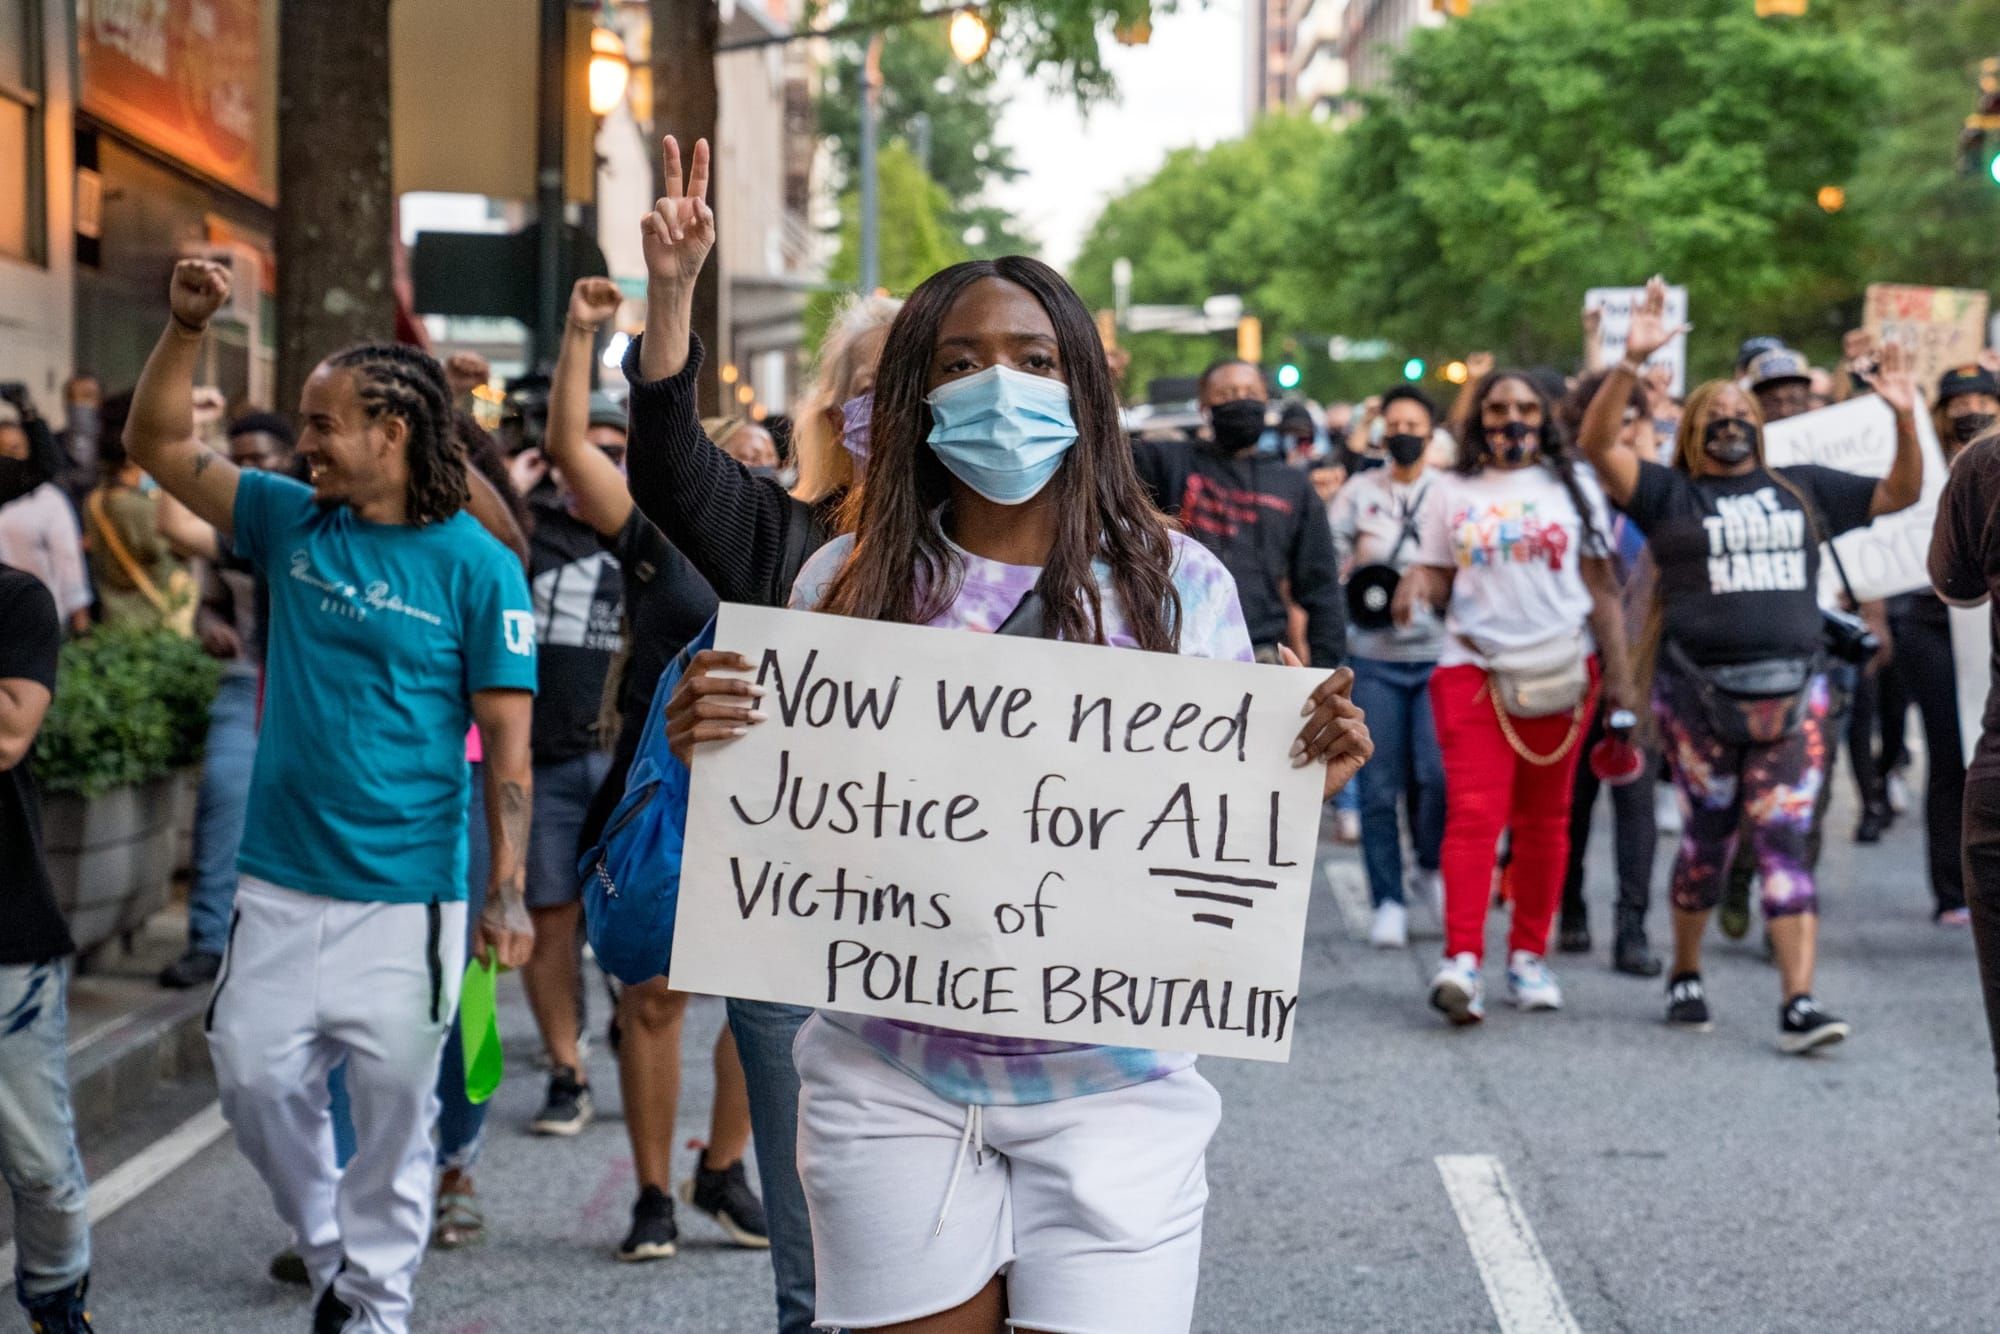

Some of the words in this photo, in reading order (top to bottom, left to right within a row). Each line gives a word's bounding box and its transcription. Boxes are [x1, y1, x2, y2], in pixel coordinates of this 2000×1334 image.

[1703, 510, 1804, 556] TODAY
[1716, 486, 1781, 518] NOT
[1708, 550, 1806, 594] KAREN
[751, 648, 902, 730] Now
[937, 679, 1037, 739] we
[1069, 692, 1253, 762] need
[730, 750, 989, 843] Justice
[1023, 774, 1124, 850] for
[1138, 782, 1297, 868] ALL
[730, 857, 952, 930] Victims
[994, 871, 1065, 937] of
[827, 939, 1019, 1015] POLICE
[1042, 965, 1298, 1043] BRUTALITY
